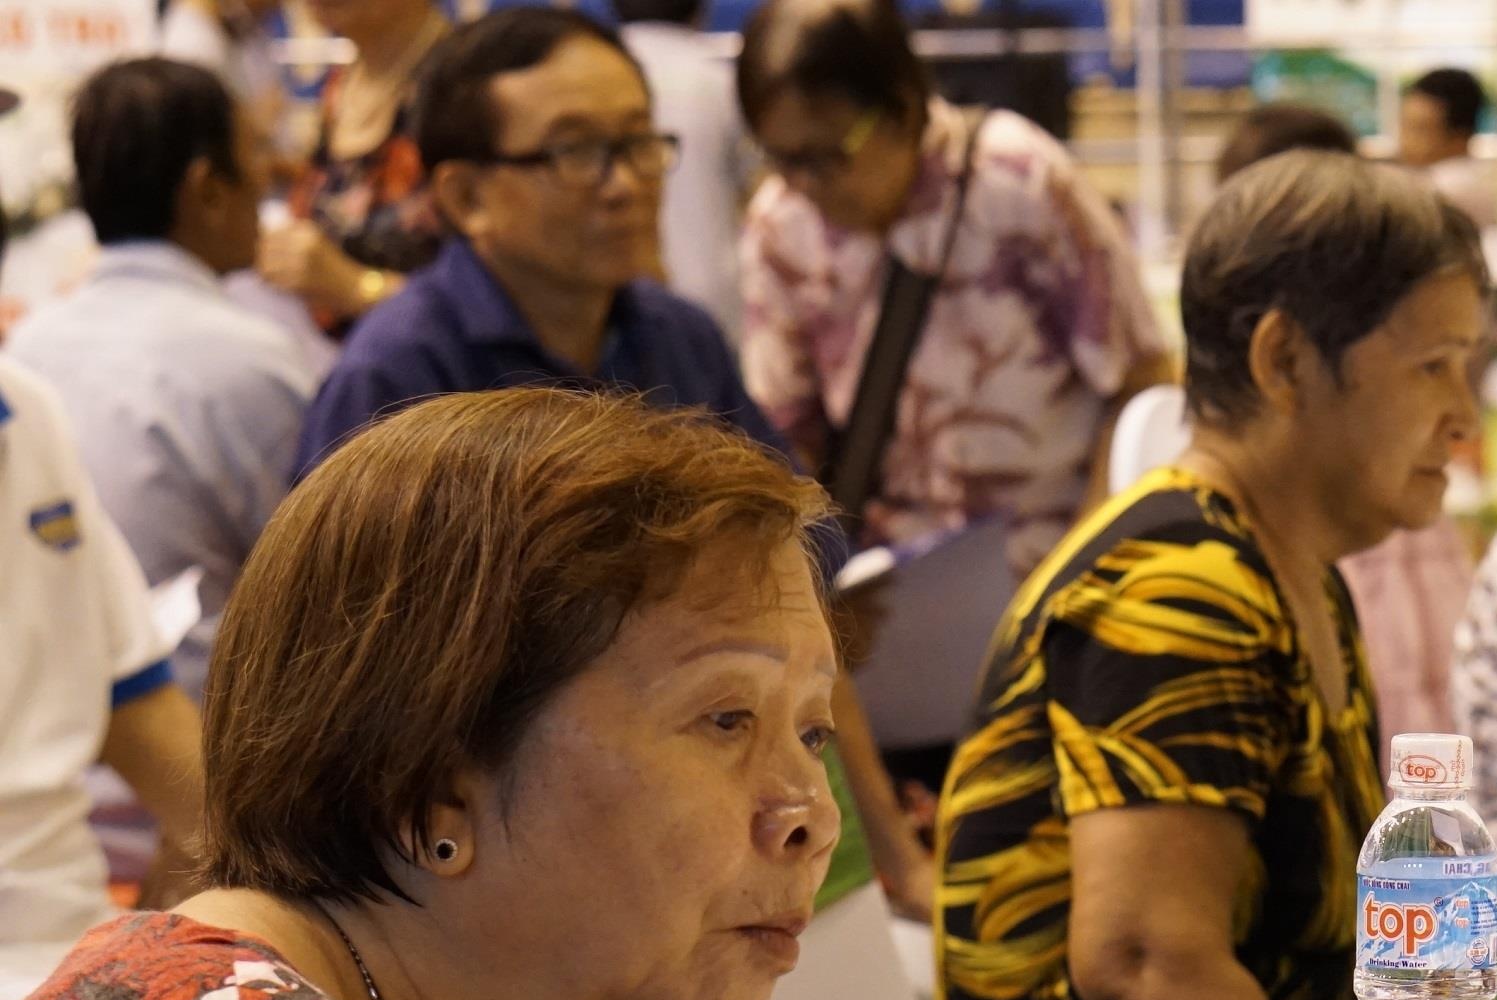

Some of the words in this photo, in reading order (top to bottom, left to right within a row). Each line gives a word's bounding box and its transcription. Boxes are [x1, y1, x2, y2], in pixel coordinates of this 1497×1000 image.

[1407, 763, 1436, 783] top
[1364, 894, 1436, 955] top
[1369, 958, 1400, 968] Drinking
[1402, 960, 1428, 968] Water
